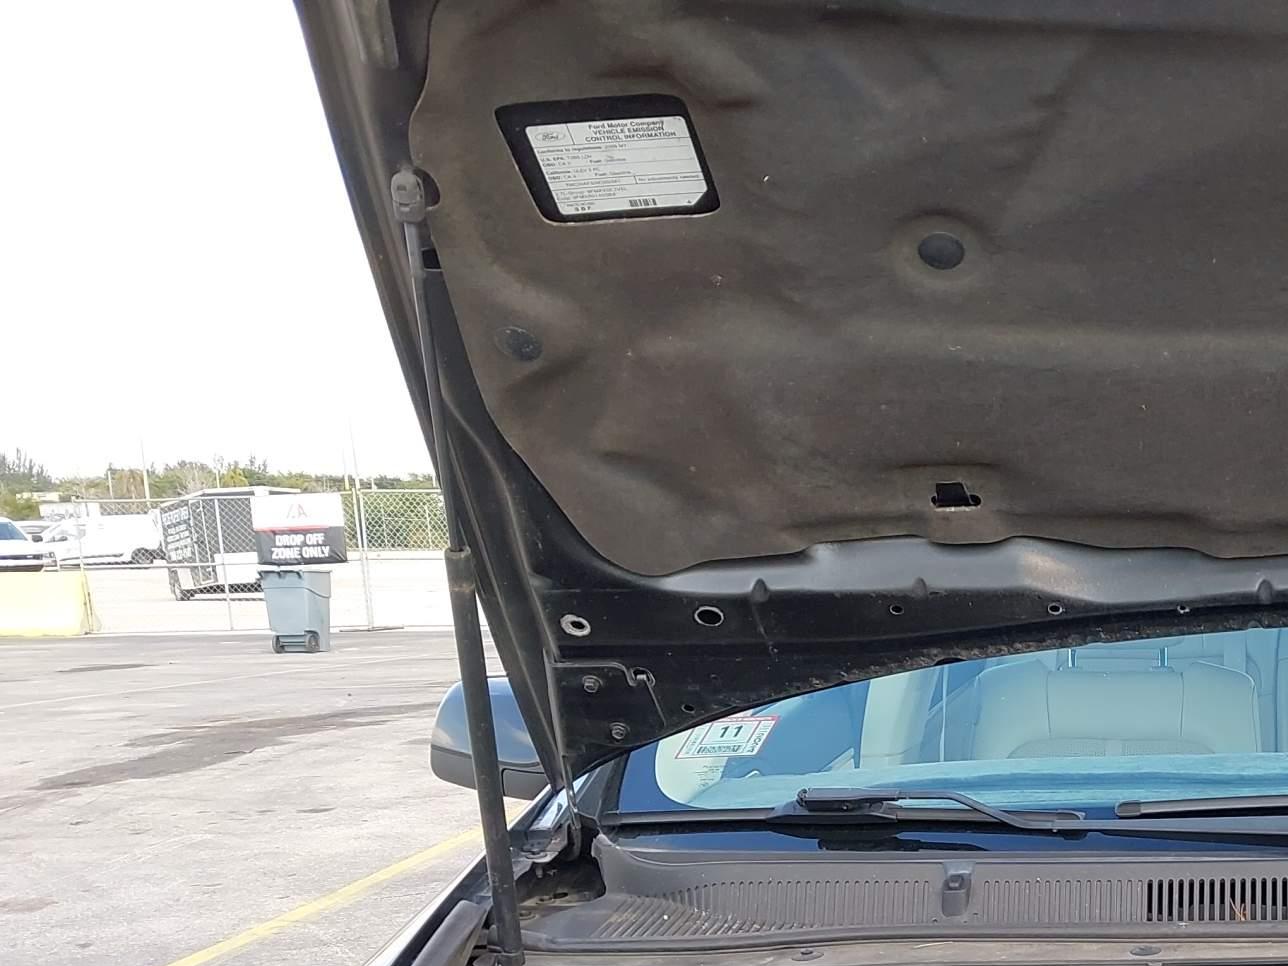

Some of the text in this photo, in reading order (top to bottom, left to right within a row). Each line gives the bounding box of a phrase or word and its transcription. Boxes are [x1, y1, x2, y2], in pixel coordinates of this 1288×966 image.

[592, 125, 665, 136] VEHICLE EMISSION
[607, 121, 628, 129] Motor
[629, 120, 664, 130] Company
[584, 130, 677, 143] CONTROL INFORMATION
[275, 532, 325, 547] DROP OFF
[271, 545, 330, 560] ZONE ONLY
[719, 725, 744, 739] 11
